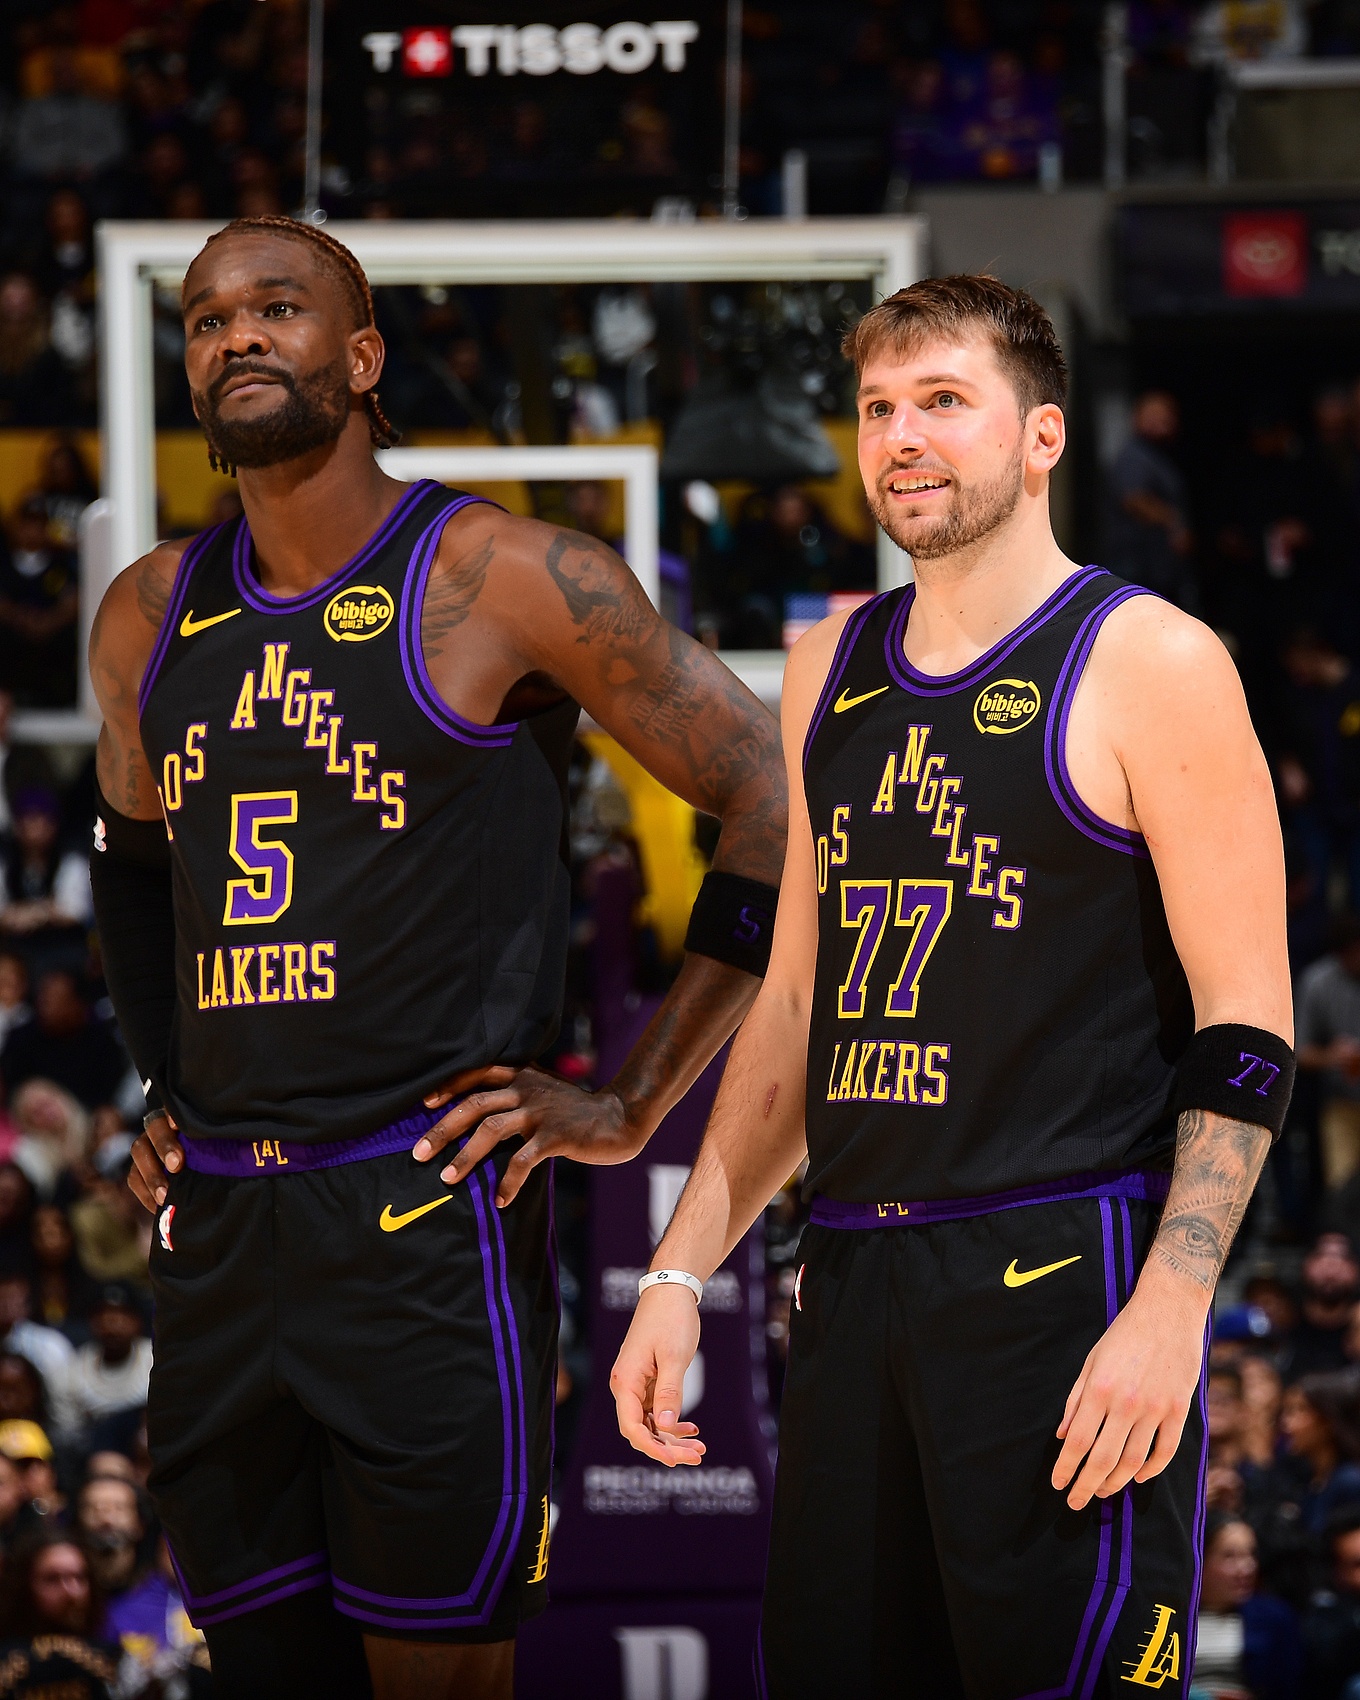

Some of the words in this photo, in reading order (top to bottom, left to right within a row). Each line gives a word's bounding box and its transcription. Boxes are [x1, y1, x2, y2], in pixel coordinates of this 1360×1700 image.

[452, 20, 698, 76] TISSOT
[331, 600, 390, 625] bibigo
[339, 620, 364, 630] 비비고
[229, 642, 407, 831] ANGELES
[980, 692, 1036, 719] bibigo
[986, 712, 1009, 722] 비비고
[222, 790, 298, 926] 5
[870, 723, 1027, 931] ANGELES
[196, 940, 337, 1012] LAKERS
[837, 878, 954, 1019] 77
[826, 1039, 952, 1107] LAKERS
[1226, 1051, 1281, 1097] 77
[252, 1139, 289, 1167] LAL
[1120, 1603, 1180, 1690] LA
